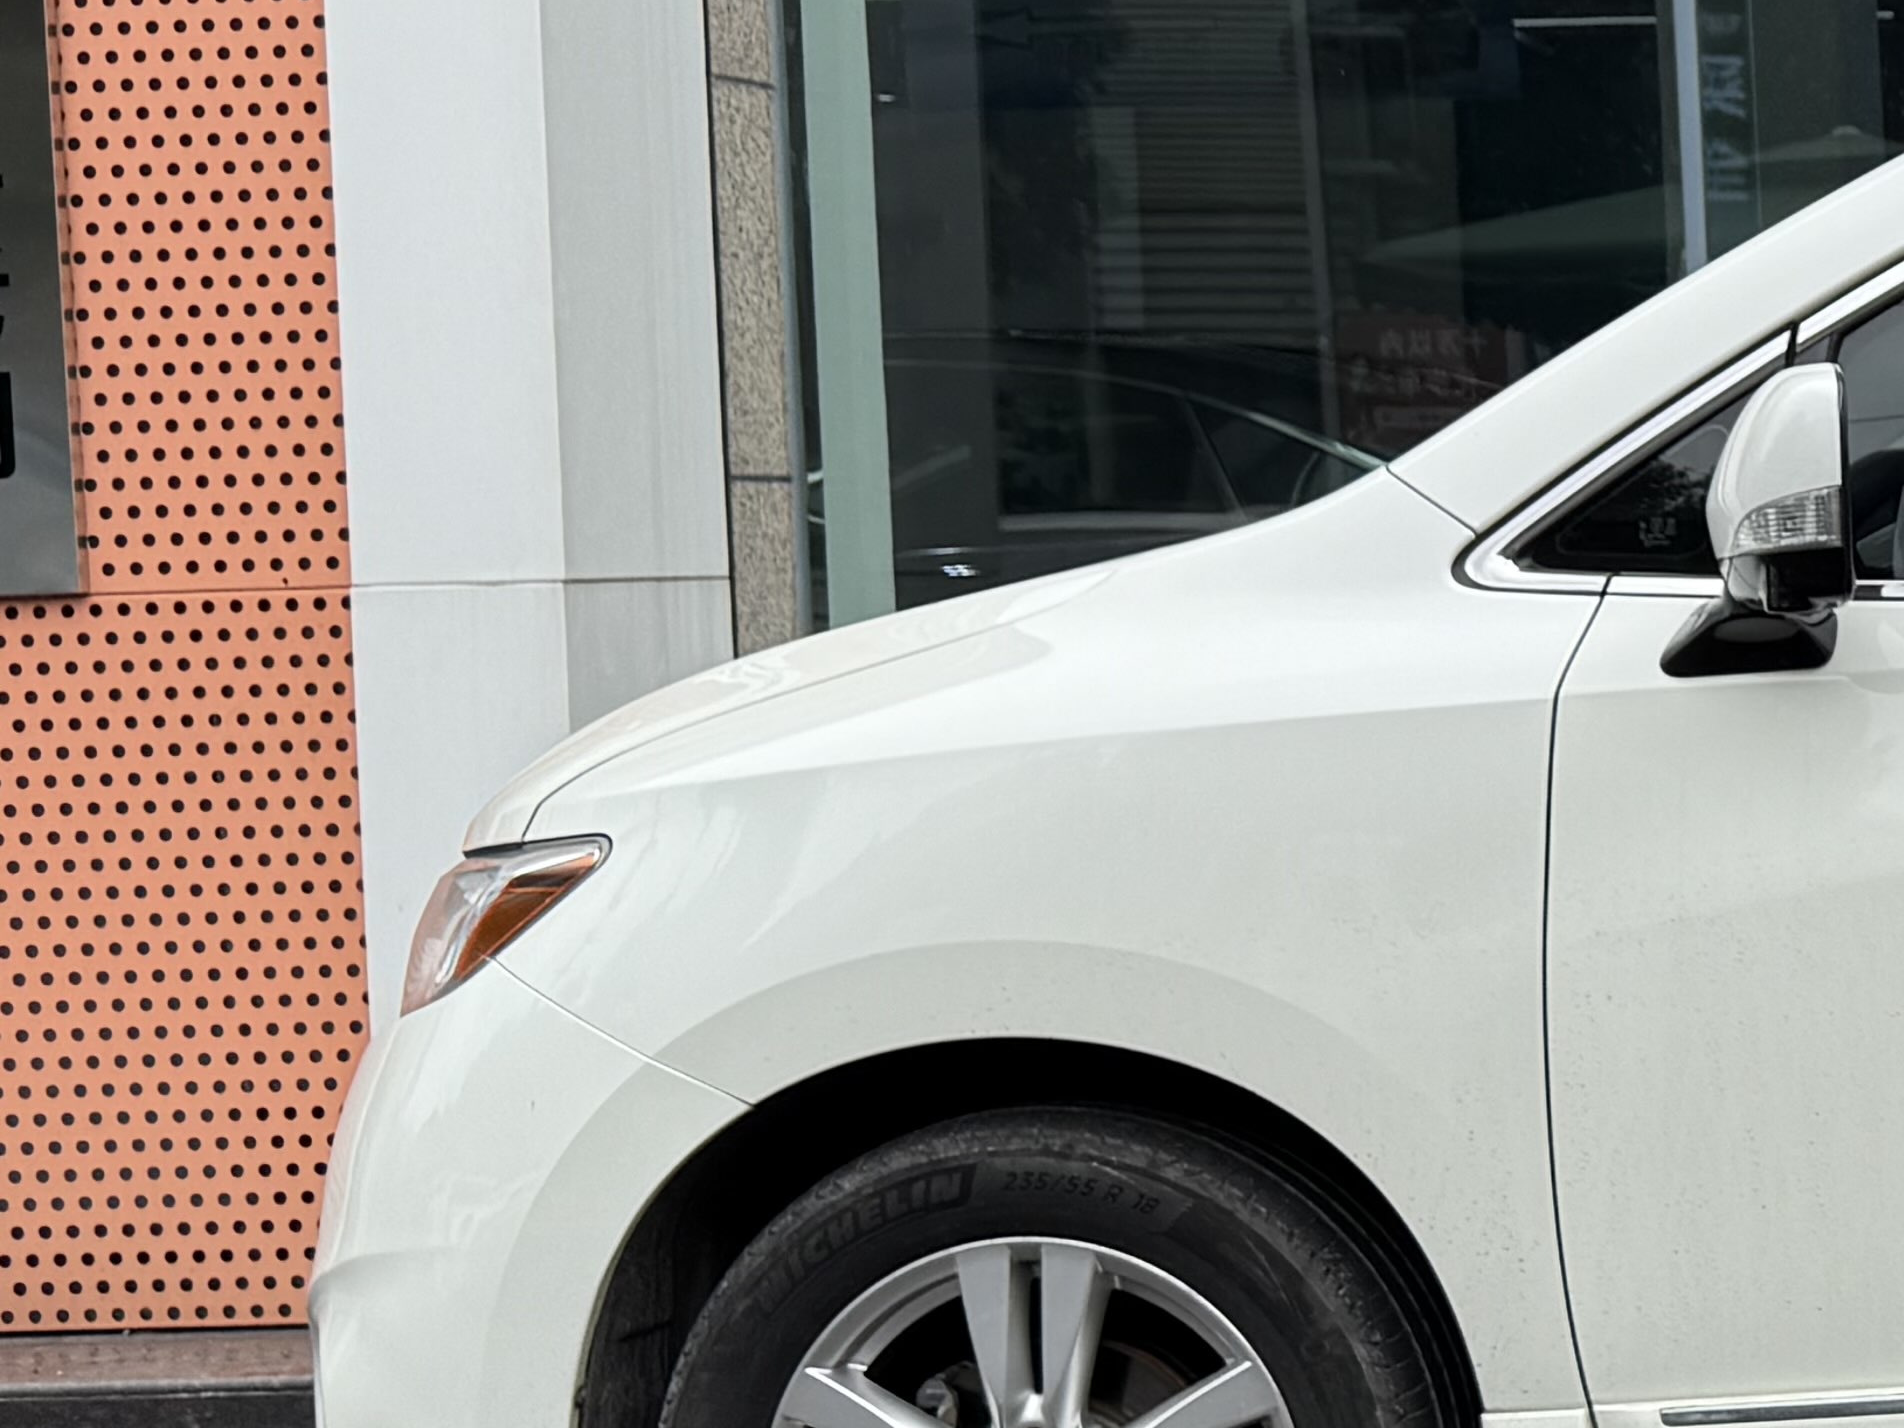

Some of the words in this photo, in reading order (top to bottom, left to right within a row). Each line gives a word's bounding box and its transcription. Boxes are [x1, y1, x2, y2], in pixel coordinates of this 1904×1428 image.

[756, 1170, 964, 1313] MICHELIN
[1003, 1170, 1099, 1198] 235/55
[1103, 1183, 1126, 1204] R
[1131, 1193, 1161, 1216] 18
